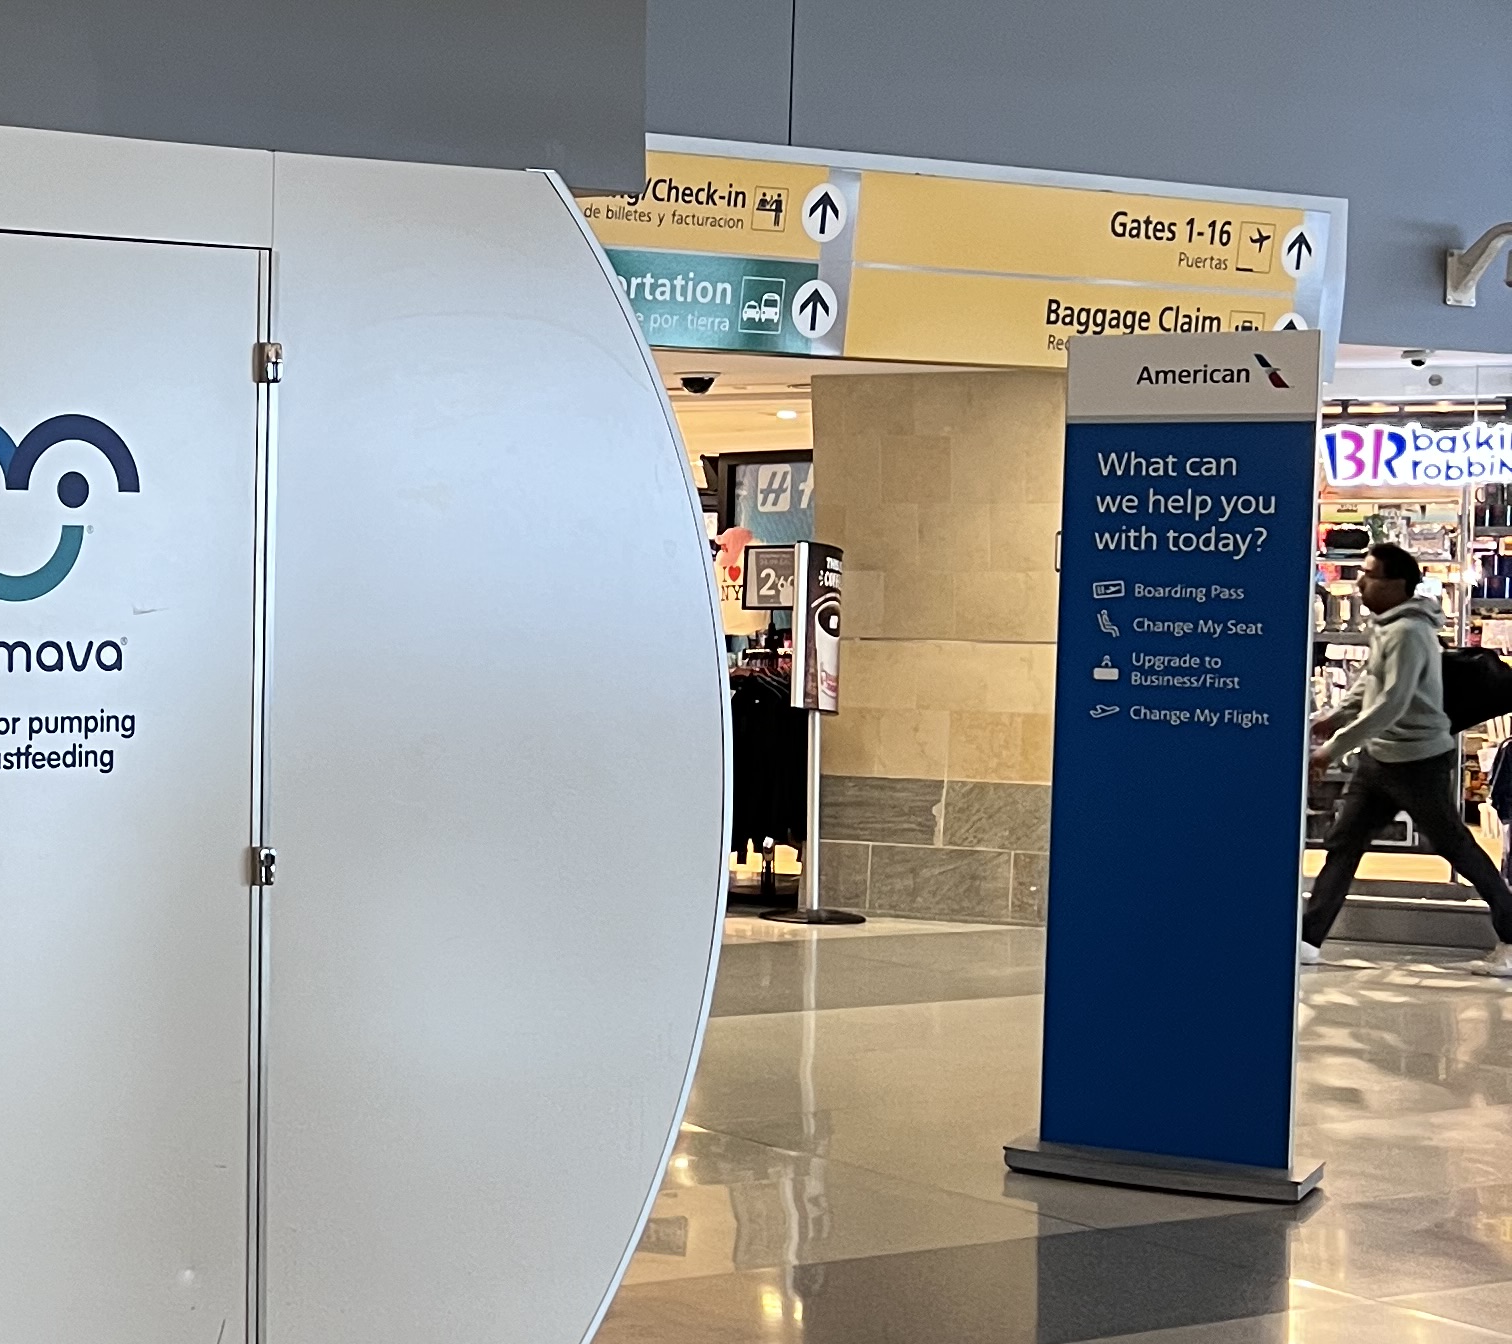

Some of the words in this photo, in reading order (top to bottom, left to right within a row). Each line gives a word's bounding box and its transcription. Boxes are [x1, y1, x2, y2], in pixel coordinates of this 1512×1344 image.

[584, 203, 601, 219] de
[606, 204, 652, 223] billetes
[657, 212, 666, 227] y
[1110, 211, 1177, 242] Gates
[1186, 217, 1232, 247] 1-16
[1178, 252, 1228, 271] Puertas
[650, 313, 679, 332] por
[688, 311, 730, 332] tierra
[1046, 298, 1151, 335] Baggage
[1159, 306, 1221, 334] Claim
[1137, 364, 1250, 385] American
[1412, 427, 1512, 453] baski
[1097, 451, 1178, 476] What
[1186, 457, 1237, 477] can
[1324, 429, 1406, 480] BR
[1096, 494, 1139, 514] we
[1149, 488, 1212, 521] help
[1218, 495, 1276, 522] you
[1094, 525, 1157, 551] with
[1166, 525, 1268, 560] today?
[722, 566, 728, 582] I
[721, 585, 743, 601] NY
[1134, 583, 1207, 603] Boarding
[1210, 585, 1245, 600] Pass
[1133, 618, 1194, 637] Change
[1197, 620, 1223, 638] My
[1227, 619, 1263, 635] Seat
[1132, 652, 1200, 671] Upgrade
[1205, 655, 1222, 669] to
[1131, 671, 1240, 689] Business/First
[28, 709, 136, 741] pumping
[1130, 706, 1191, 725] Change
[1194, 708, 1220, 727] My
[1224, 709, 1269, 729] Flight
